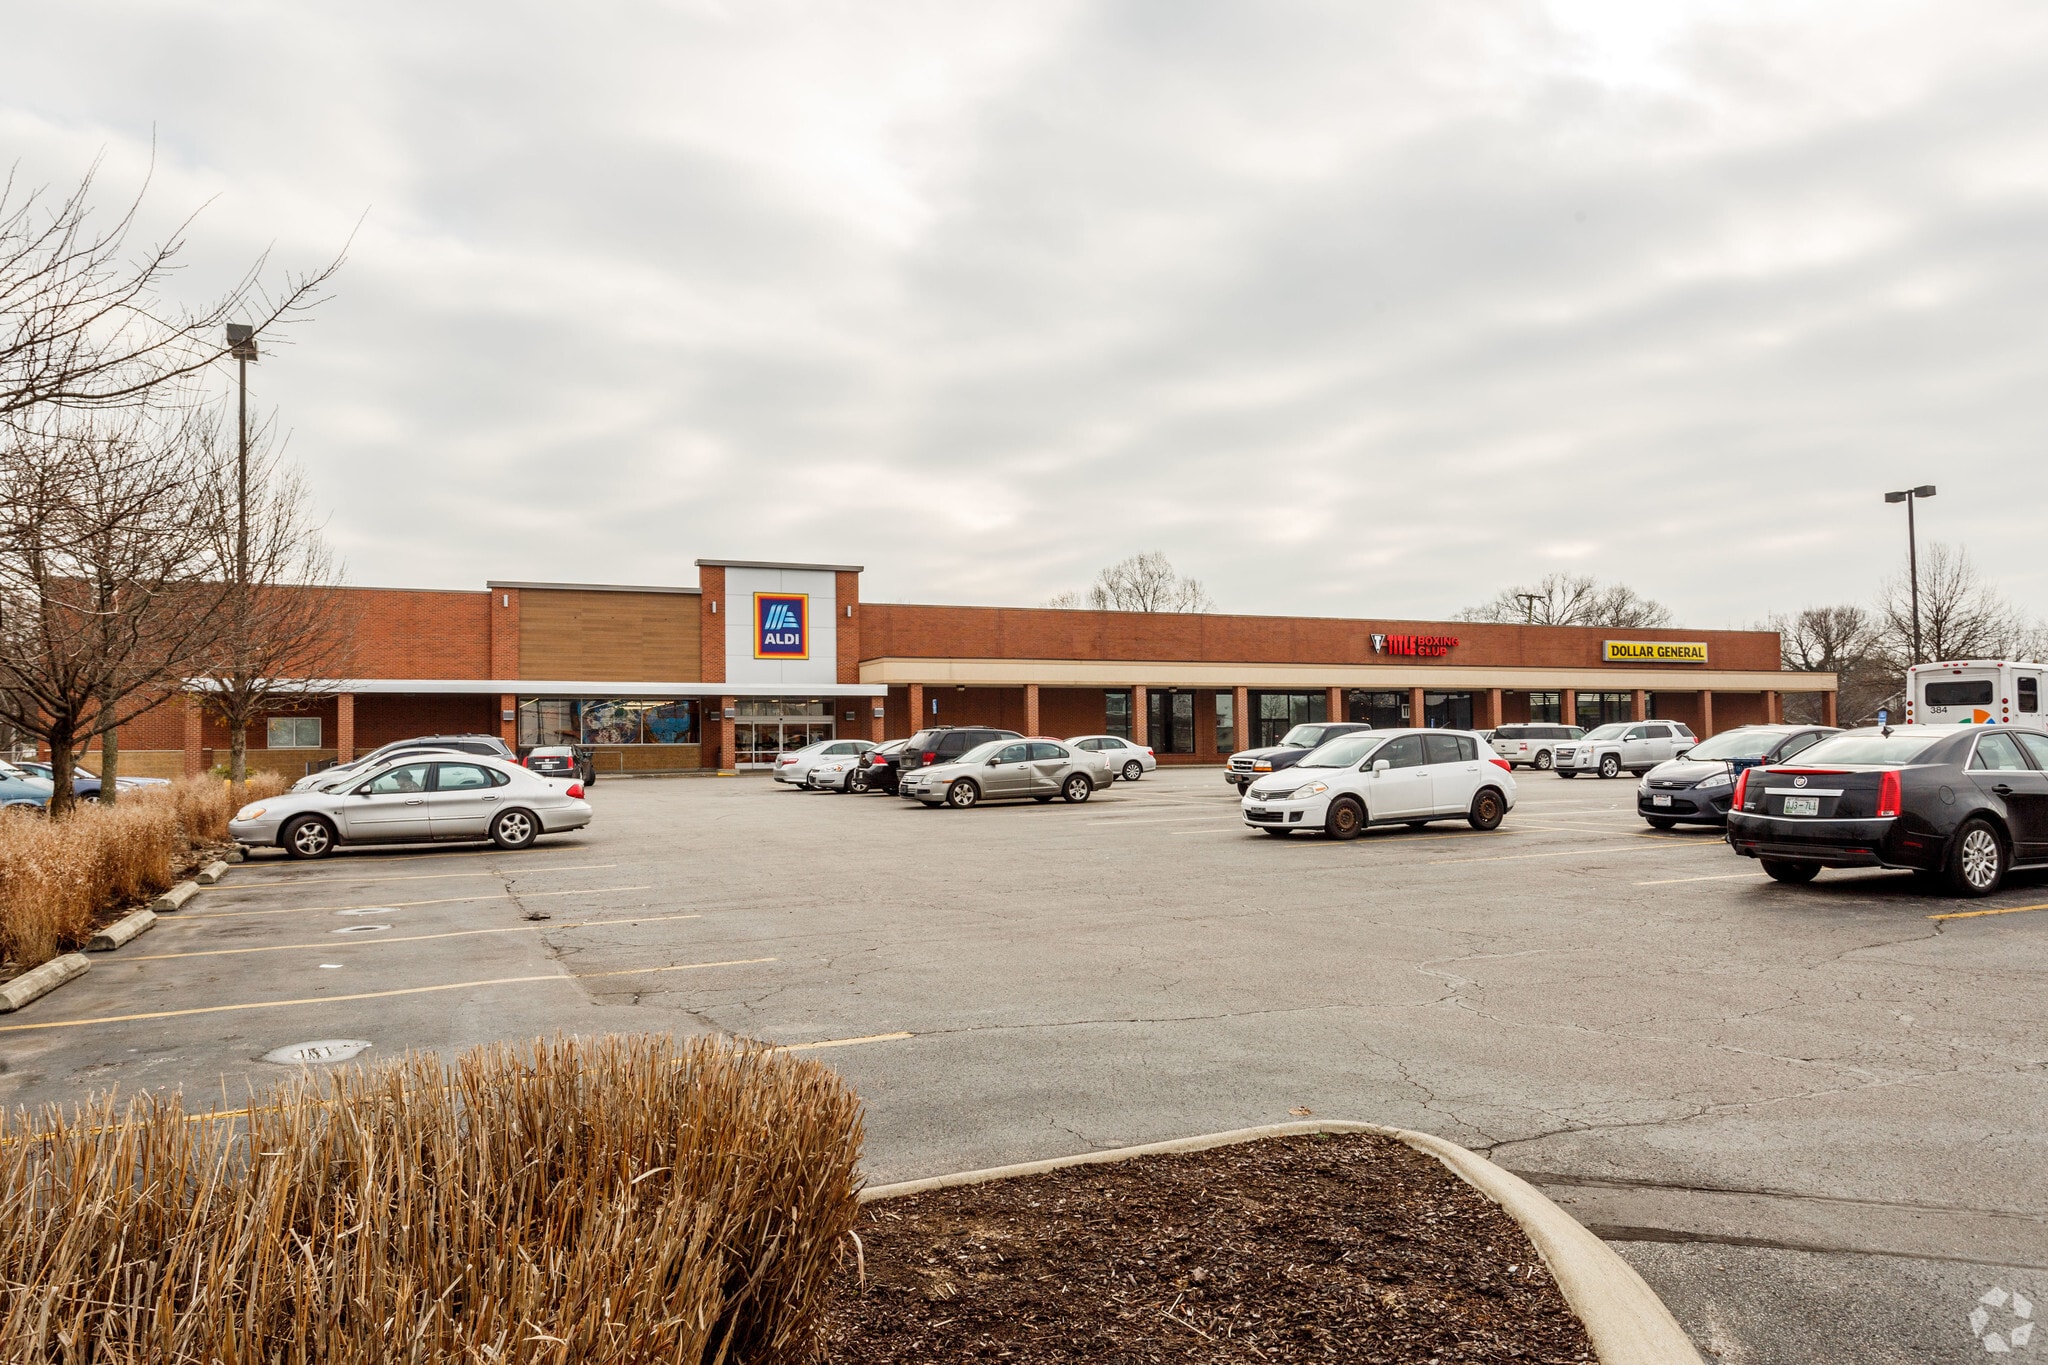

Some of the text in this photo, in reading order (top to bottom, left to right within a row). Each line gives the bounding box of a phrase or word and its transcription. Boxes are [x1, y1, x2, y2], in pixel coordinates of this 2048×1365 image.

[764, 633, 800, 645] ALDI
[1386, 634, 1416, 655] TITLE
[1417, 635, 1459, 647] BOXING
[1418, 646, 1448, 657] CLUB
[1611, 645, 1704, 658] DOLLAR GENERAL
[1930, 706, 1948, 714] 384
